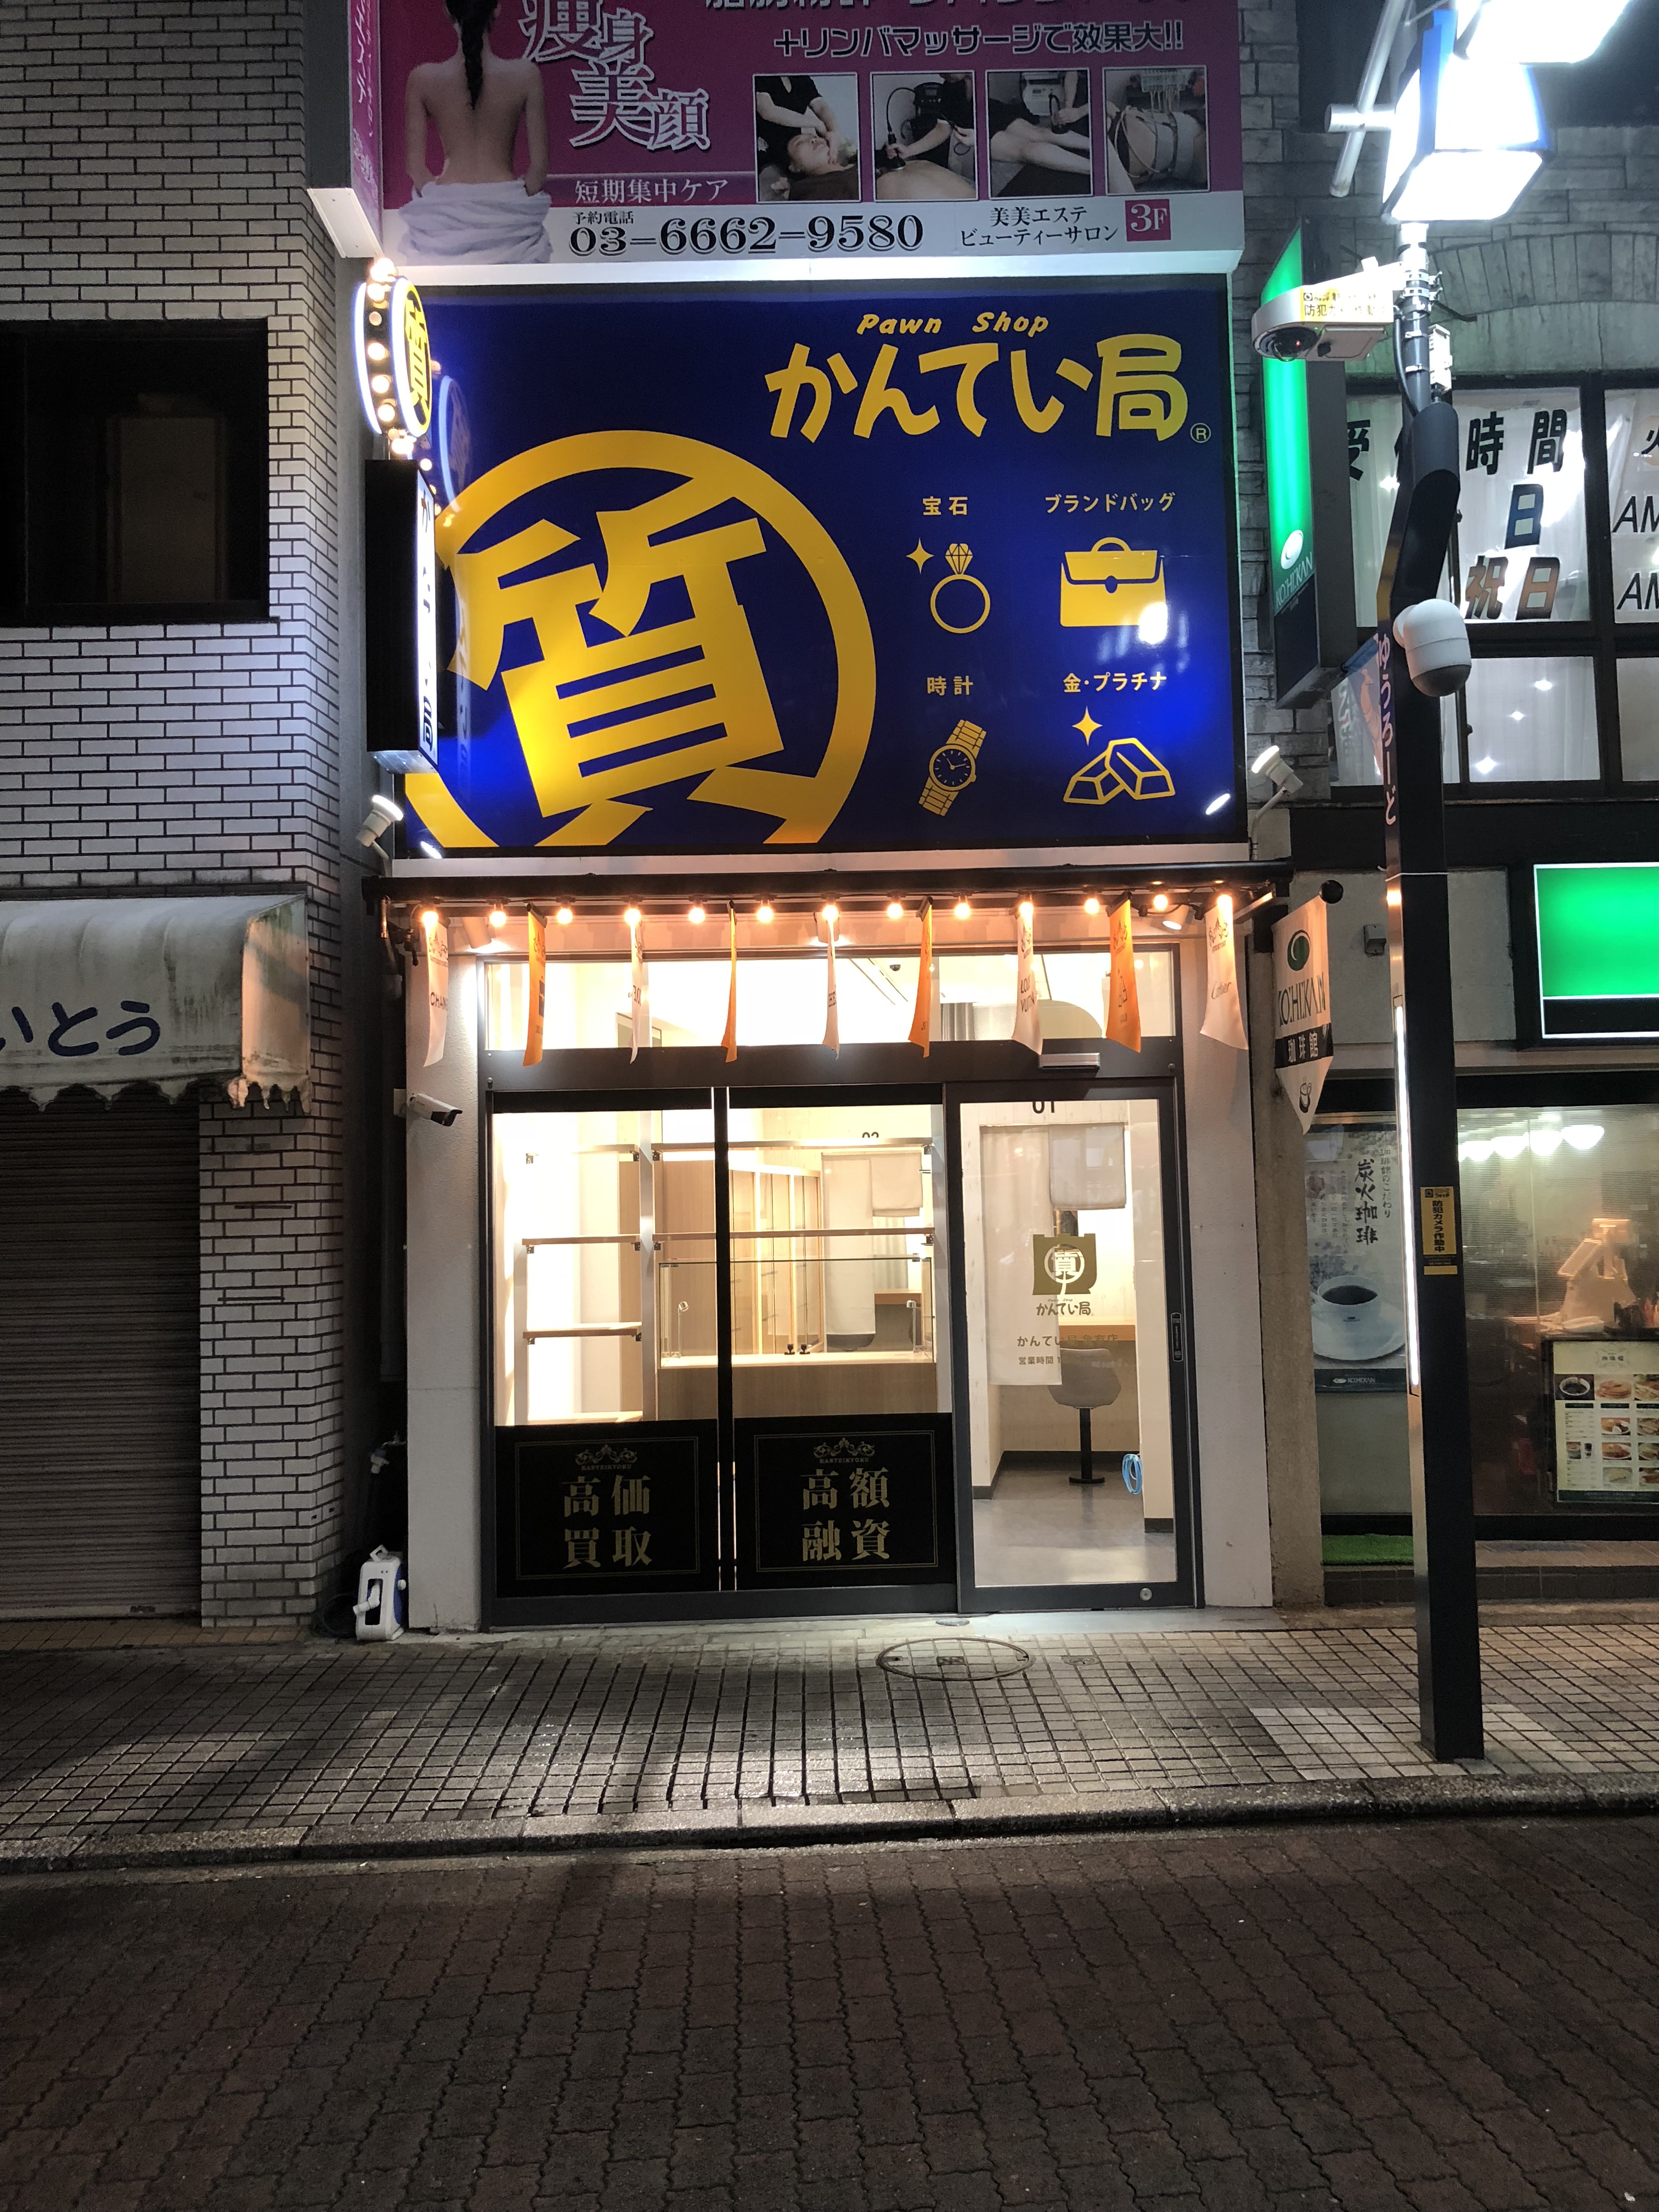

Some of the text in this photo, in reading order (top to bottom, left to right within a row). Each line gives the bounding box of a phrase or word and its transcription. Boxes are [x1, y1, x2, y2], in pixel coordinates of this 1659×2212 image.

[569, 58, 712, 151] 美顔
[574, 178, 730, 204] 短期集中ケア
[573, 211, 634, 225] 予約電話
[990, 206, 1088, 228] 美美エステ
[1130, 203, 1168, 232] 3F
[961, 225, 1119, 247] ビューティーサロン
[856, 311, 1050, 337] Pawn Shop
[765, 333, 1188, 443] かんてい局
[922, 495, 969, 516] 宝石
[1045, 492, 1176, 514] ブランドバッグ
[1464, 555, 1561, 620] 祝日
[442, 461, 850, 847] 質
[927, 675, 974, 696] 時計
[1355, 1158, 1379, 1245] 炭火珈琲
[1432, 1200, 1445, 1252] 防犯カメラ作動中
[1036, 1301, 1091, 1316] かんてい局
[1018, 1356, 1054, 1365] 営業時間
[562, 1475, 651, 1517] 高価
[801, 1466, 890, 1510] 高額
[562, 1525, 652, 1569] 買取
[802, 1519, 890, 1562] 融資
